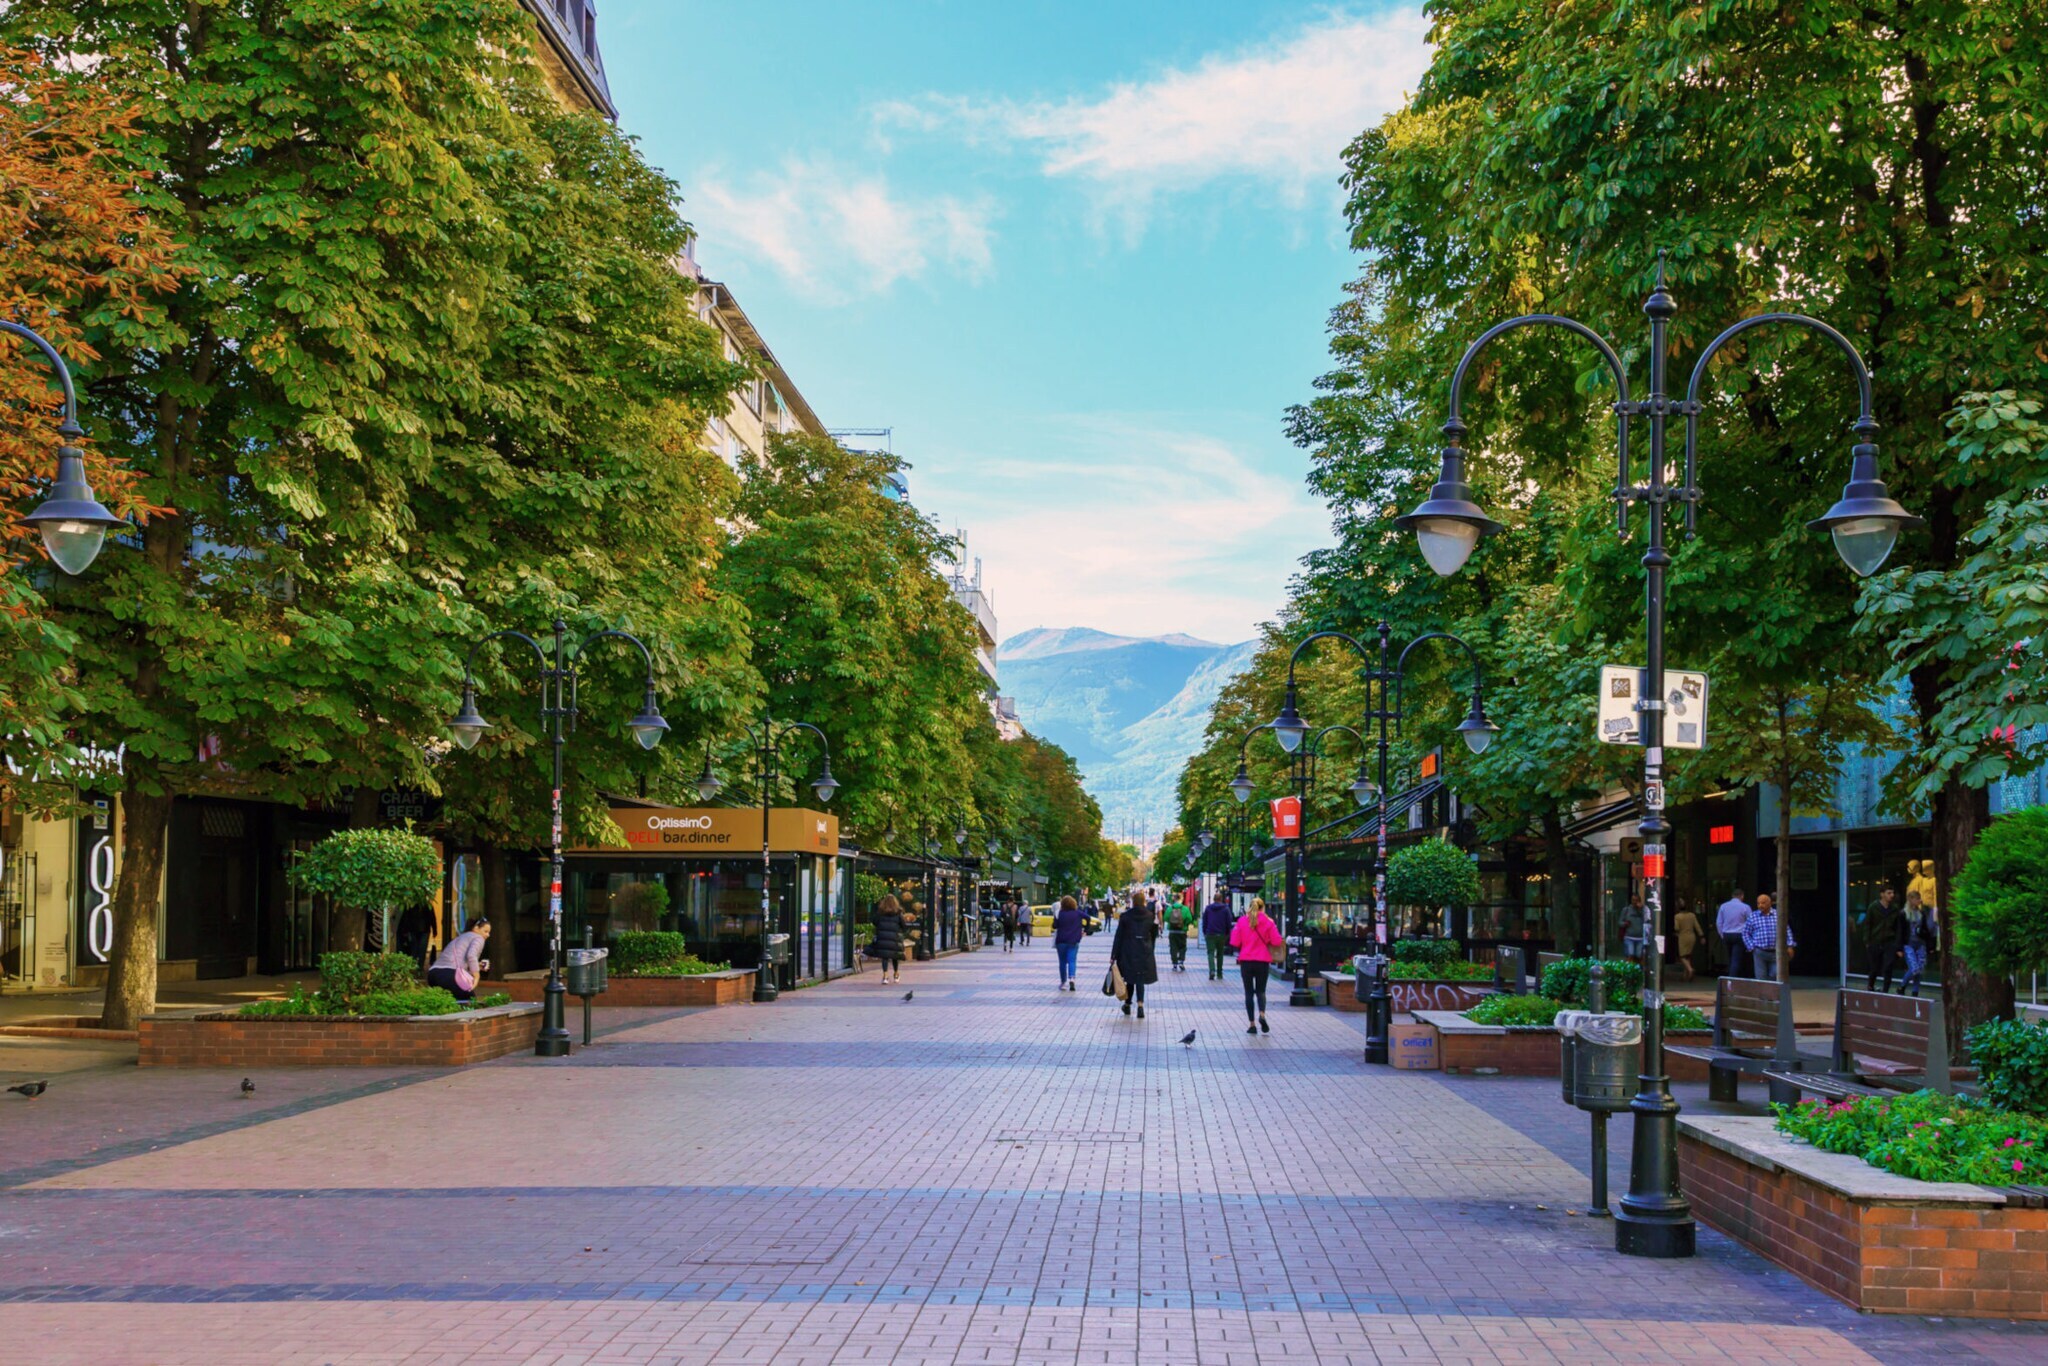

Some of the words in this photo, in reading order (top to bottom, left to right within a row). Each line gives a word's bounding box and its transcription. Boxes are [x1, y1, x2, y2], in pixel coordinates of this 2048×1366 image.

[381, 792, 428, 805] CRAFT
[387, 805, 424, 817] BEER
[627, 831, 659, 844] DELI
